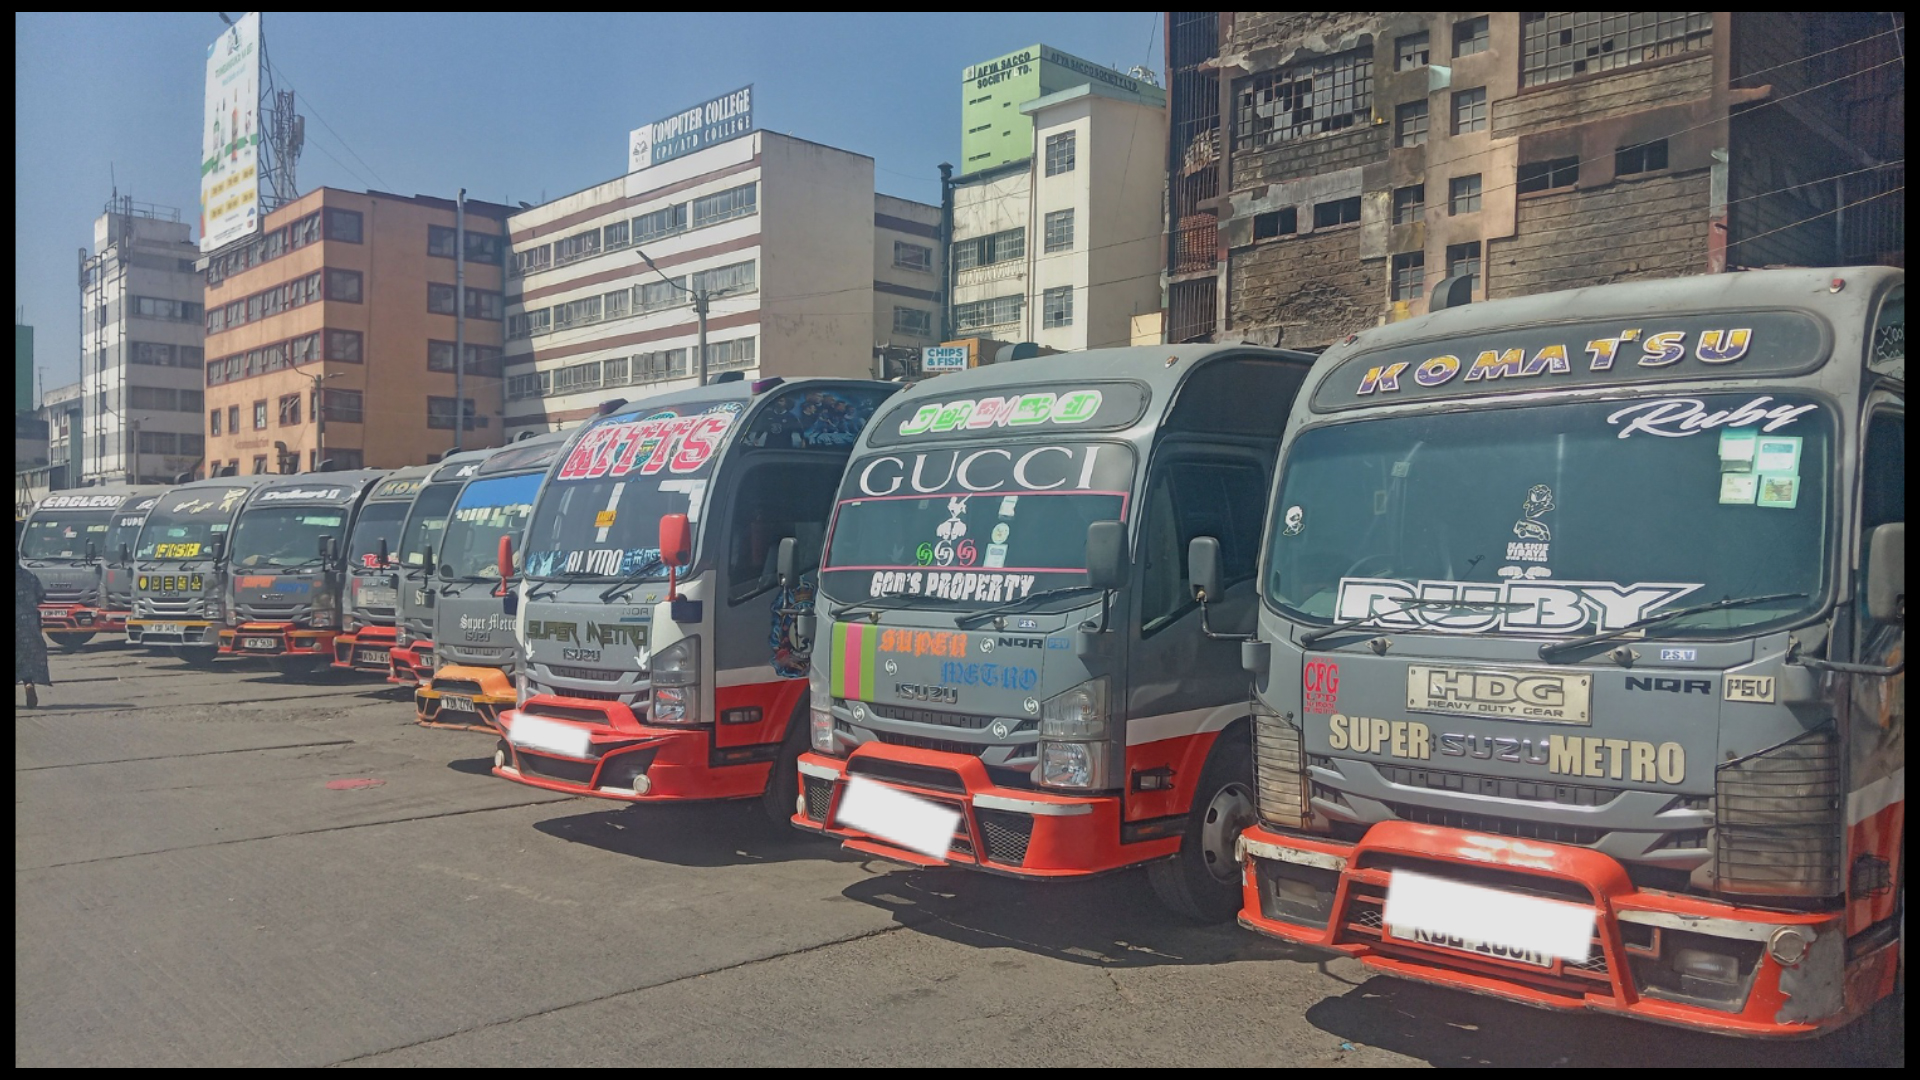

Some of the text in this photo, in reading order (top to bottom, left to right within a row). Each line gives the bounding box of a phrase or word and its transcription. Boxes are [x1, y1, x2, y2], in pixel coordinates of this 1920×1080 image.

[978, 51, 1031, 77] AFYA SACCO
[1051, 52, 1070, 67] AFYA
[1070, 58, 1094, 77] SACCO
[977, 70, 1011, 89] SOCIETY
[652, 88, 750, 145] COMPUTER COLLEGE
[656, 117, 750, 160] CPA/ATD COLLEGE
[927, 348, 963, 357] CHIPS
[927, 357, 963, 366] & FISH
[1356, 328, 1752, 396] KOMATSU
[1606, 396, 1818, 439] Ruby
[859, 446, 1101, 497] GUCCI
[924, 573, 1036, 602] PROPERTY
[1333, 577, 1706, 636] RUBY
[460, 613, 486, 631] Super
[526, 619, 649, 650] SUPER METRO
[563, 647, 601, 662] ISUZU
[879, 629, 968, 658] SUPER
[997, 637, 1044, 649] NQR
[939, 661, 1038, 691] METRO
[1304, 661, 1339, 694] CFG
[1428, 670, 1565, 707] HDG
[1624, 676, 1711, 695] NQR
[1727, 678, 1772, 699] PSV
[895, 682, 958, 704] ISUZU
[1427, 700, 1564, 718] HEAVY DUTY GEAR
[1329, 714, 1686, 785] SUPER METRO
